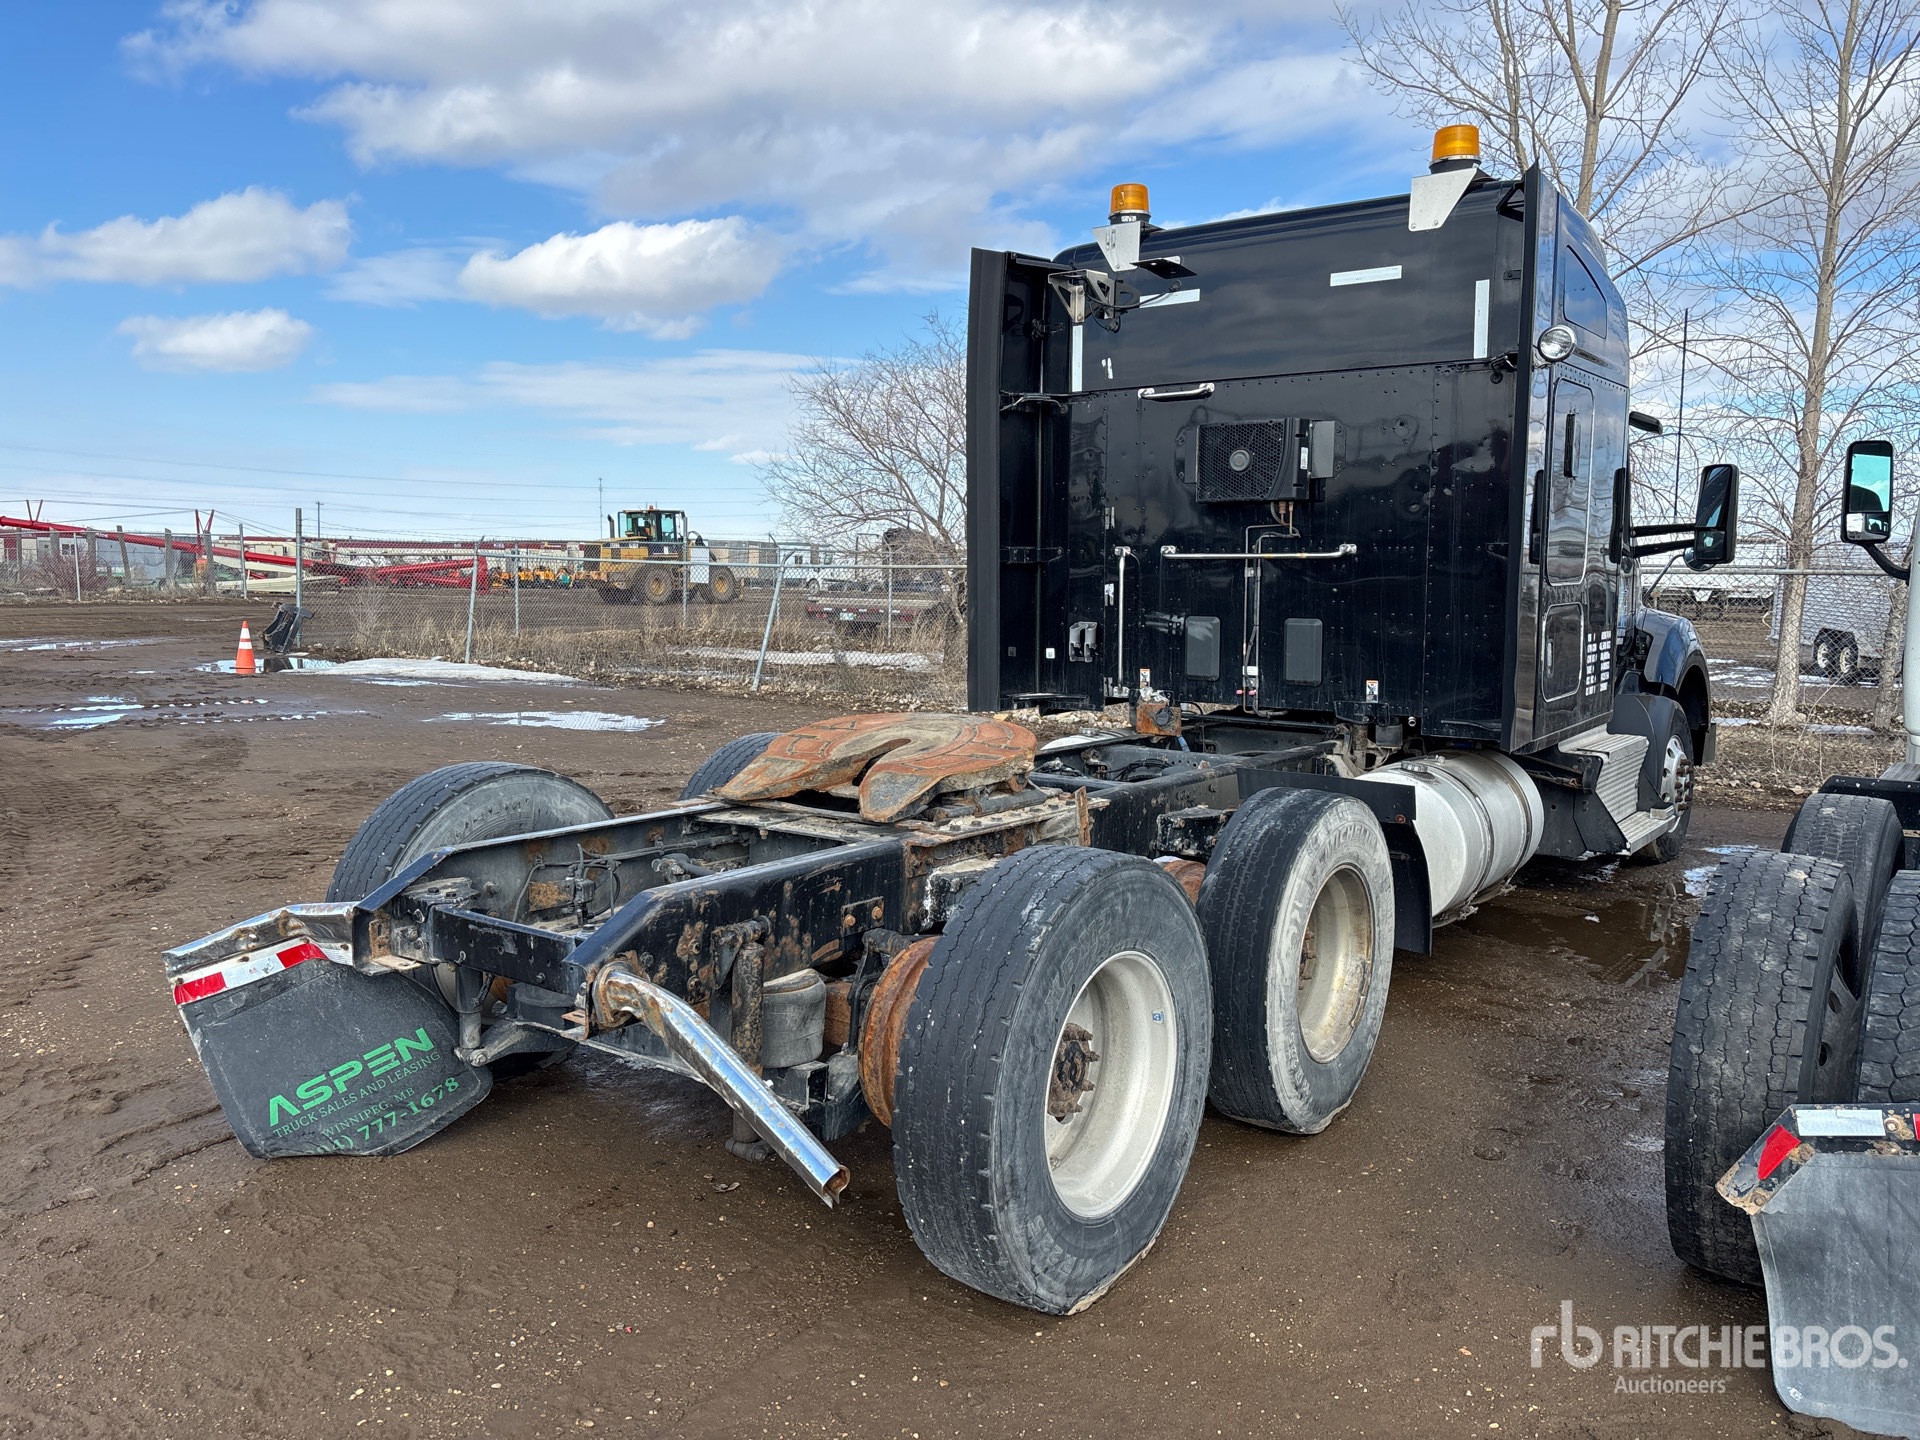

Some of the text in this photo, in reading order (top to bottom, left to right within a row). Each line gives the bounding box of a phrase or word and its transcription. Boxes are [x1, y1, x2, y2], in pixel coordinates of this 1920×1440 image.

[270, 1027, 434, 1127] ASPEN
[273, 1051, 440, 1138] TRUCK SALES AND LEASING
[357, 1077, 459, 1141] 777-1678
[393, 1087, 415, 1103] MB
